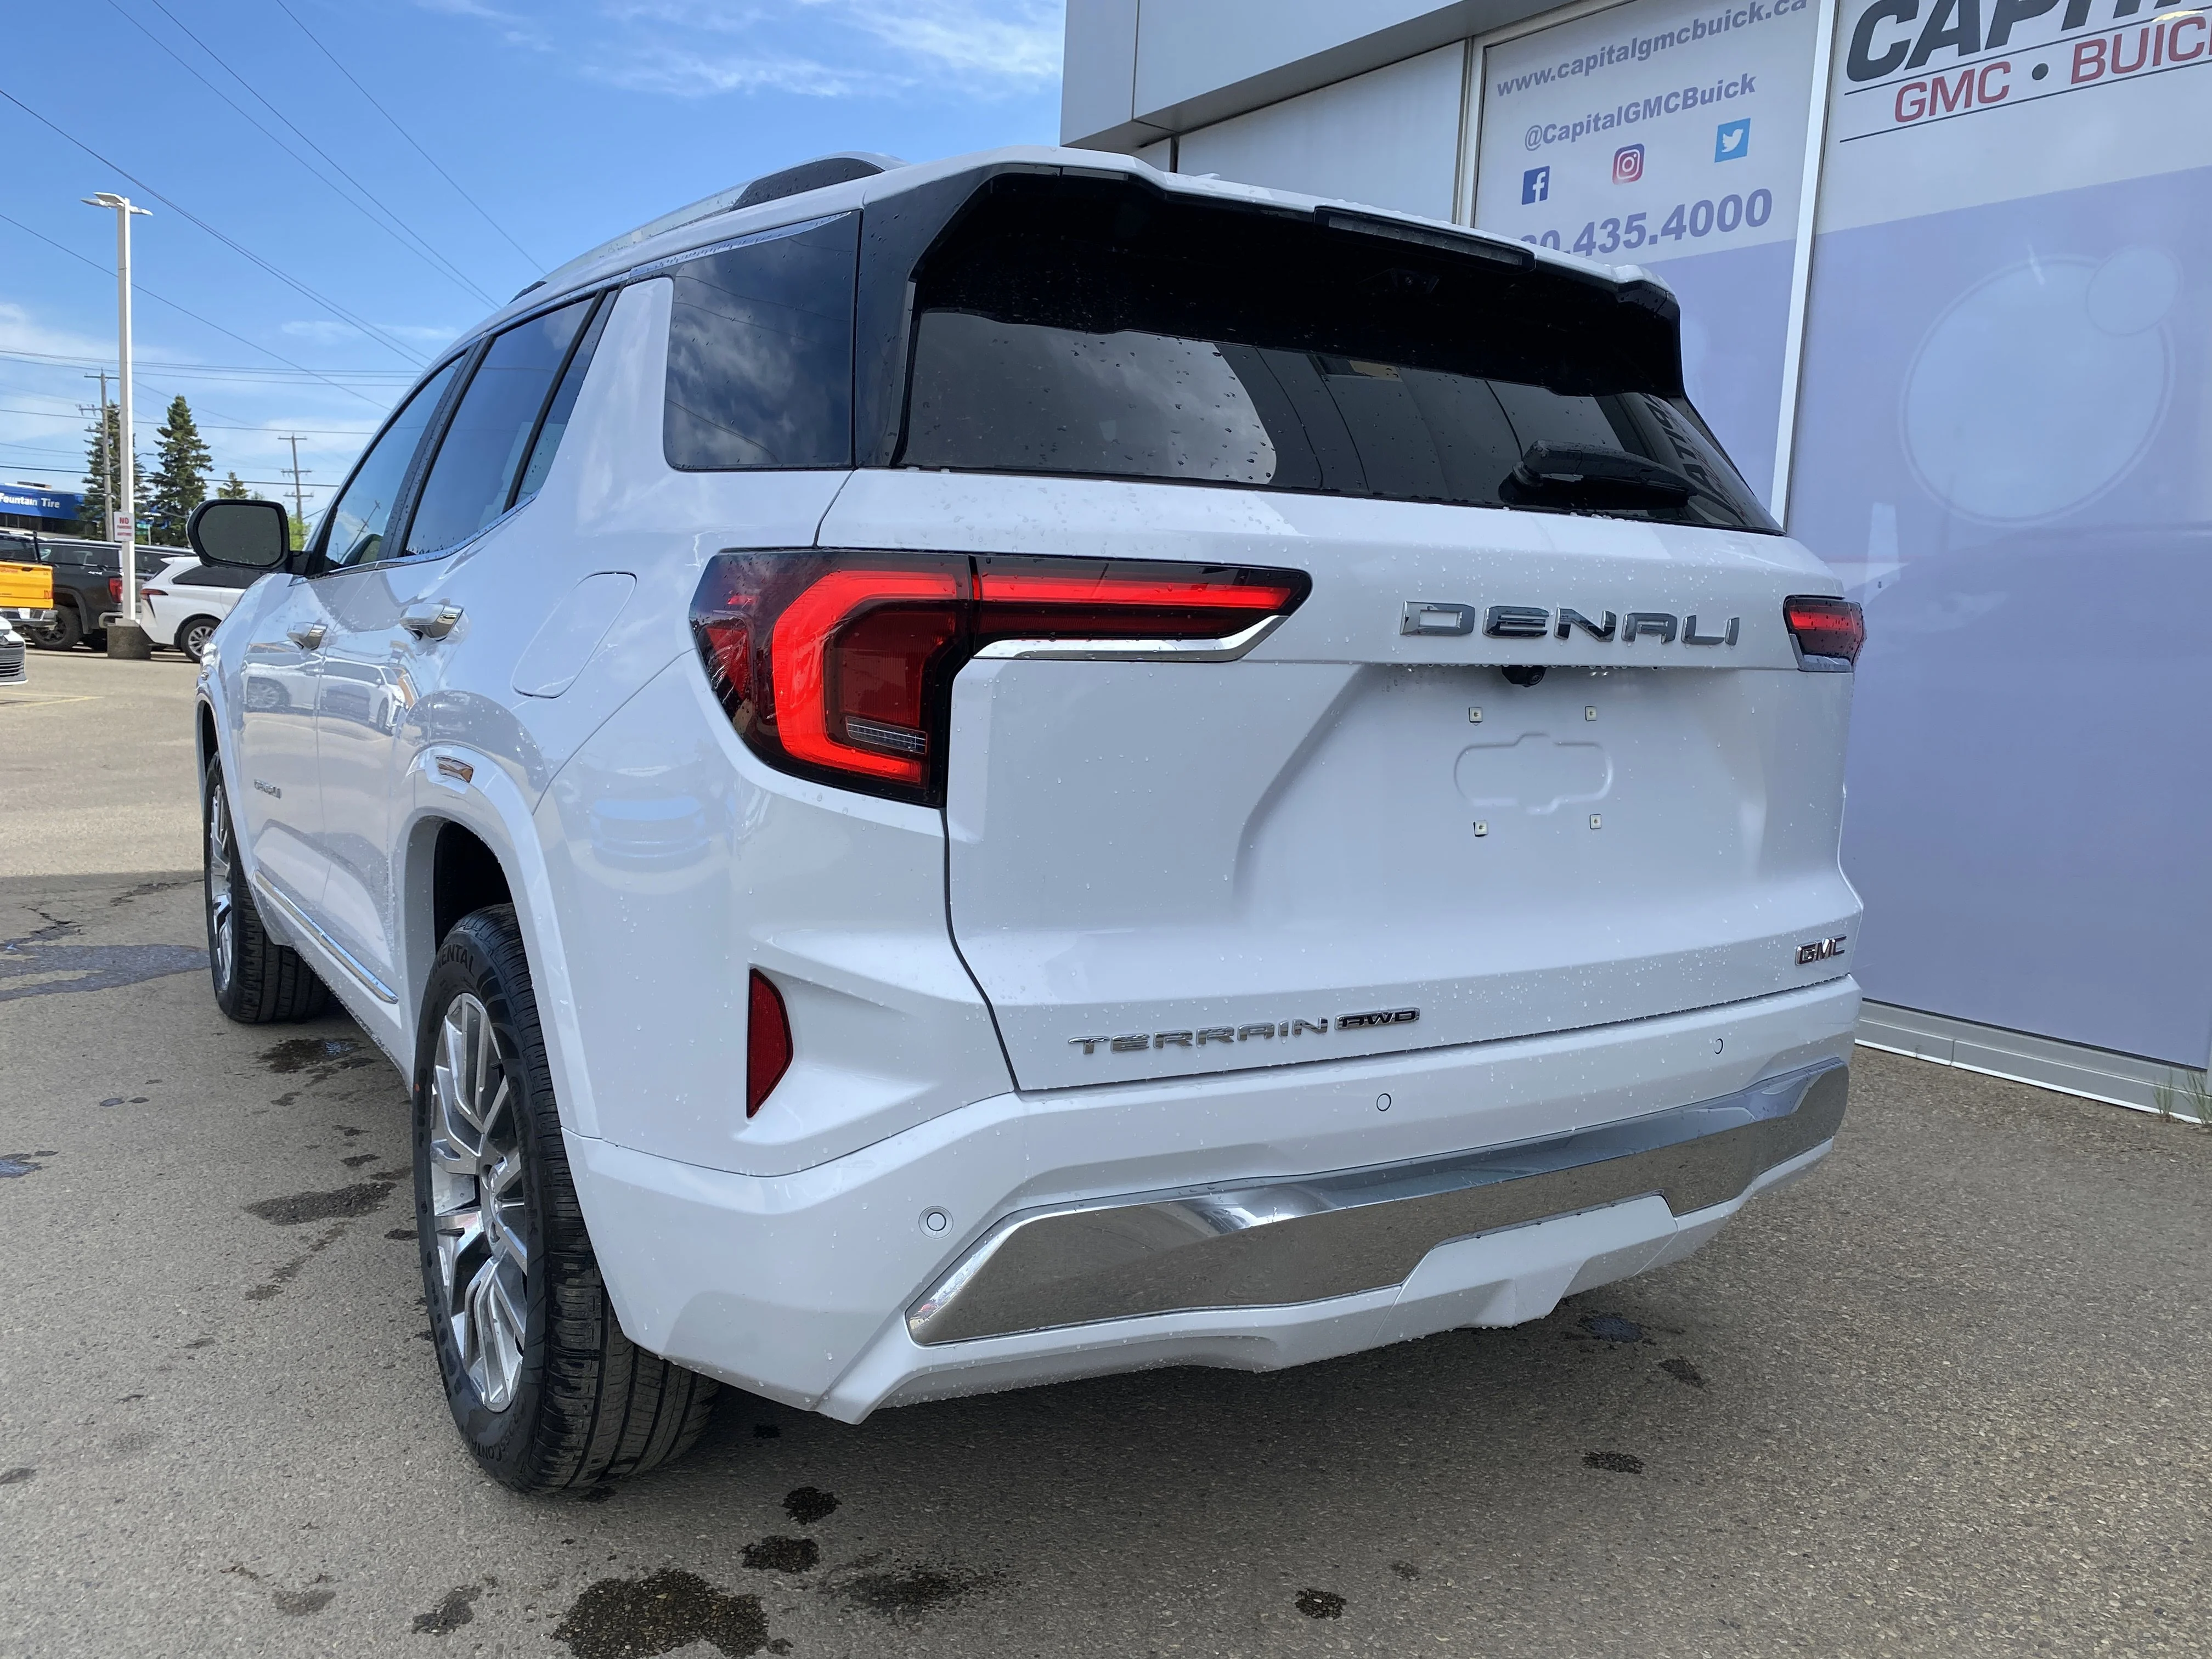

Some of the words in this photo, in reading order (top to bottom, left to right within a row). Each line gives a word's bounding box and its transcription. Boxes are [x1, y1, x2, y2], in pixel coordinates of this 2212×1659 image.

[1497, 0, 1807, 97] www.capitalgmcbuick.ca
[1847, 0, 2181, 82] CAP
[1895, 61, 2011, 122] GMC
[2071, 16, 2212, 85] BUIC
[1525, 73, 1756, 151] @CapitalGMCBuick
[41, 497, 60, 509] Tire
[1400, 600, 1740, 646] DENALI
[1795, 934, 1847, 966] GMC
[1067, 1017, 1328, 1055] TERRAIN
[1336, 1007, 1420, 1030] AWD
